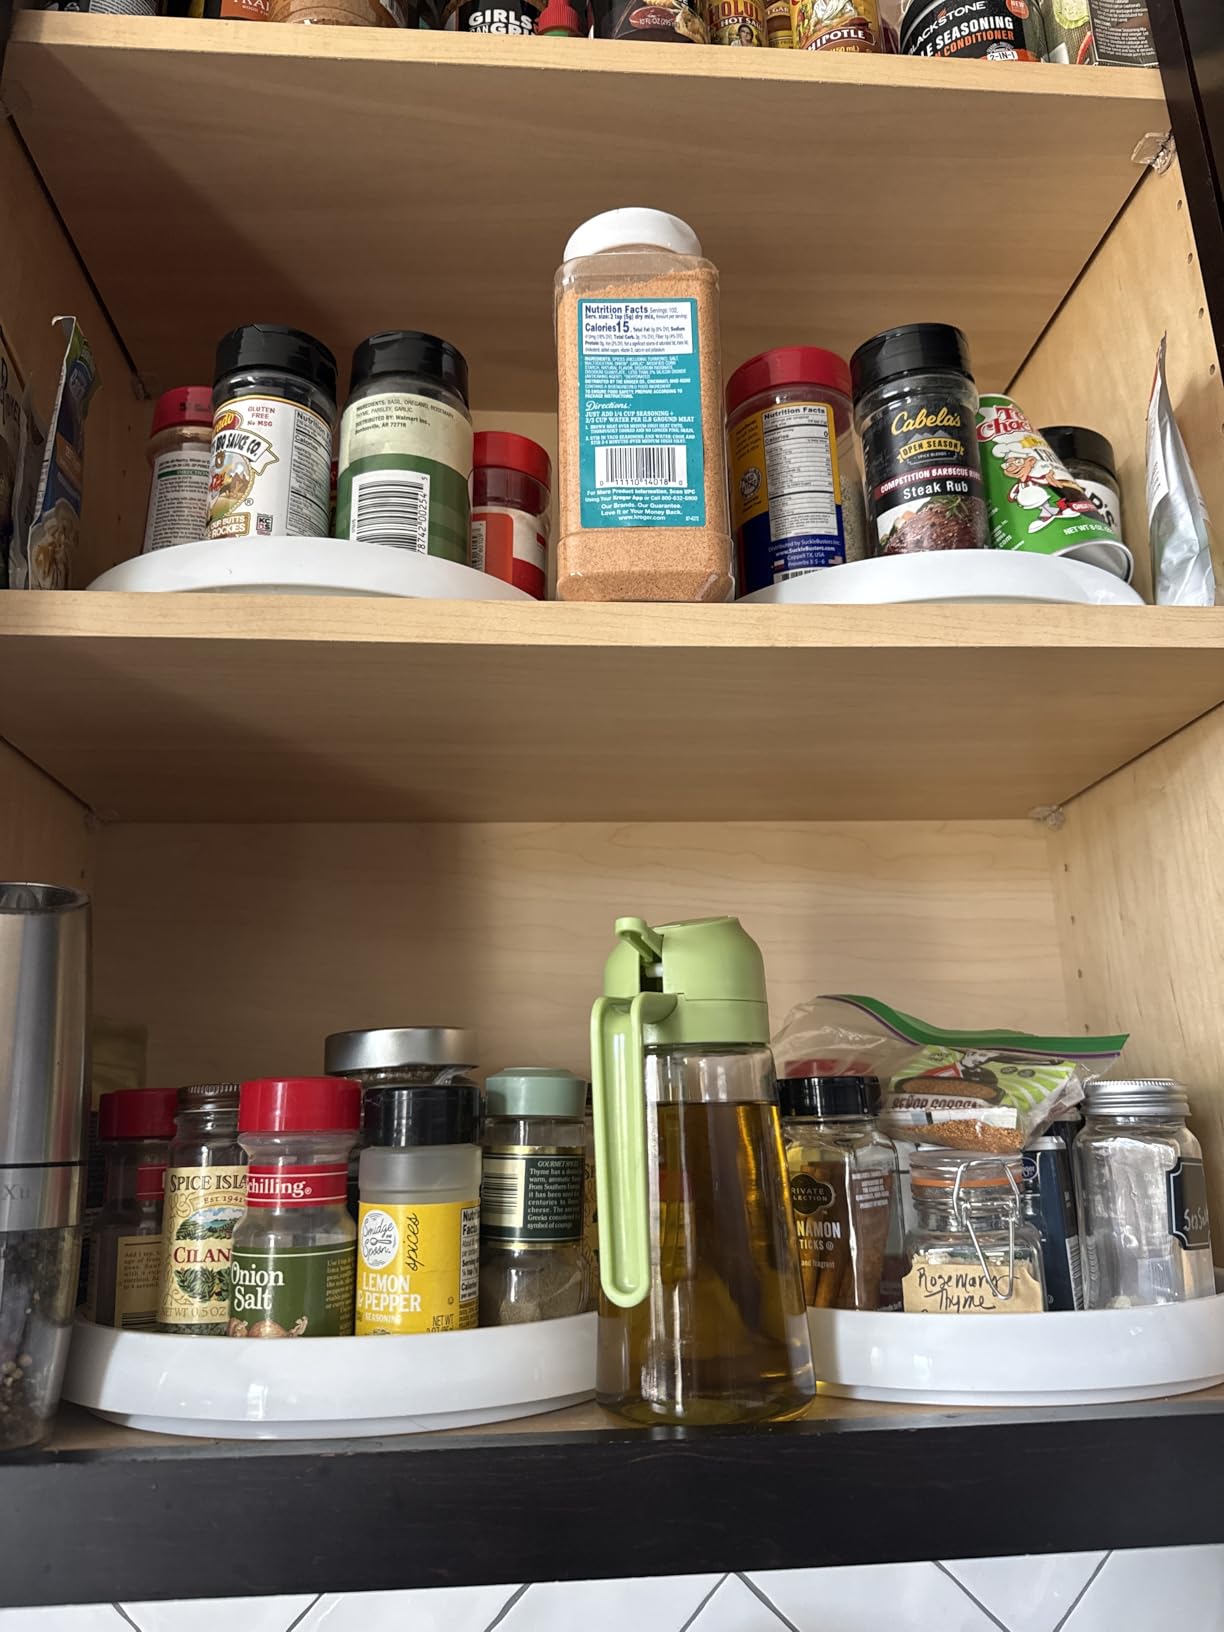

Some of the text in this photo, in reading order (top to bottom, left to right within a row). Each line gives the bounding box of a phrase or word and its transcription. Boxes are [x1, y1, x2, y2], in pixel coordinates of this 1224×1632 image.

[468, 9, 533, 30] GIRLS
[720, 16, 743, 28] HOT
[909, 2, 986, 54] BLACKSTONE
[807, 29, 865, 50] HIPOTLE
[935, 16, 1014, 50] SEASONING
[943, 30, 1015, 57] CONDITIONER
[585, 305, 648, 314] Nutrition Facts
[247, 406, 276, 414] GLUTEN
[585, 400, 632, 411] Directions:
[764, 407, 801, 421] Nutrition
[891, 407, 961, 436] Cabela's
[226, 432, 250, 450] SAUCE
[247, 439, 261, 457] CO.
[765, 434, 789, 444] Calories
[902, 440, 960, 456] OPEN SEASON
[645, 478, 669, 486] 14018
[881, 467, 969, 494] COMPETITION BARBECUE
[903, 480, 969, 500] Steak Rub
[418, 493, 428, 522] 00254
[223, 516, 245, 526] BUTTS
[1064, 525, 1090, 535] NET WT
[212, 524, 246, 538] ROCKIES
[529, 1168, 550, 1176] Thyme
[170, 1174, 213, 1193] SPICE
[203, 1196, 220, 1204] EST
[363, 1218, 393, 1238] Smidge
[527, 1222, 548, 1230] symbol
[405, 1213, 425, 1272] spices
[230, 1262, 286, 1286] Onion
[363, 1272, 411, 1293] LEMON
[233, 1285, 273, 1311] Salt
[365, 1293, 422, 1312] PEPPER
[924, 1288, 996, 1313] Thyme
[175, 1307, 189, 1318] WT
[208, 1306, 227, 1317] OZ
[364, 1313, 402, 1325] SEASONING
[432, 1314, 455, 1327] NET WT
